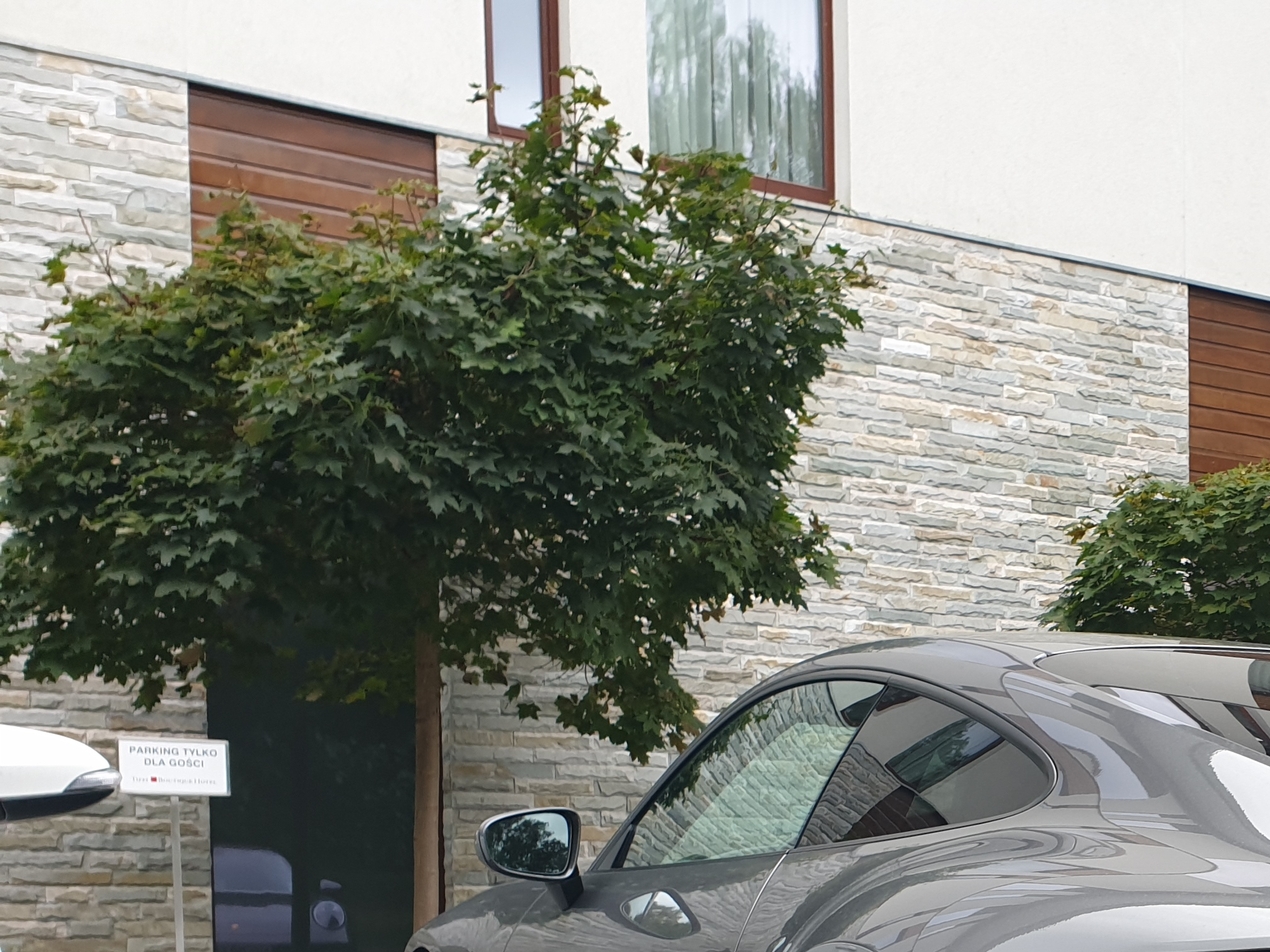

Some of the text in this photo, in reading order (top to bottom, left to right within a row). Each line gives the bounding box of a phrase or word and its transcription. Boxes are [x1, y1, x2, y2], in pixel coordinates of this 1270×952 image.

[129, 745, 218, 757] PARKING TYLKO
[144, 757, 204, 768] DLA GOŚCI
